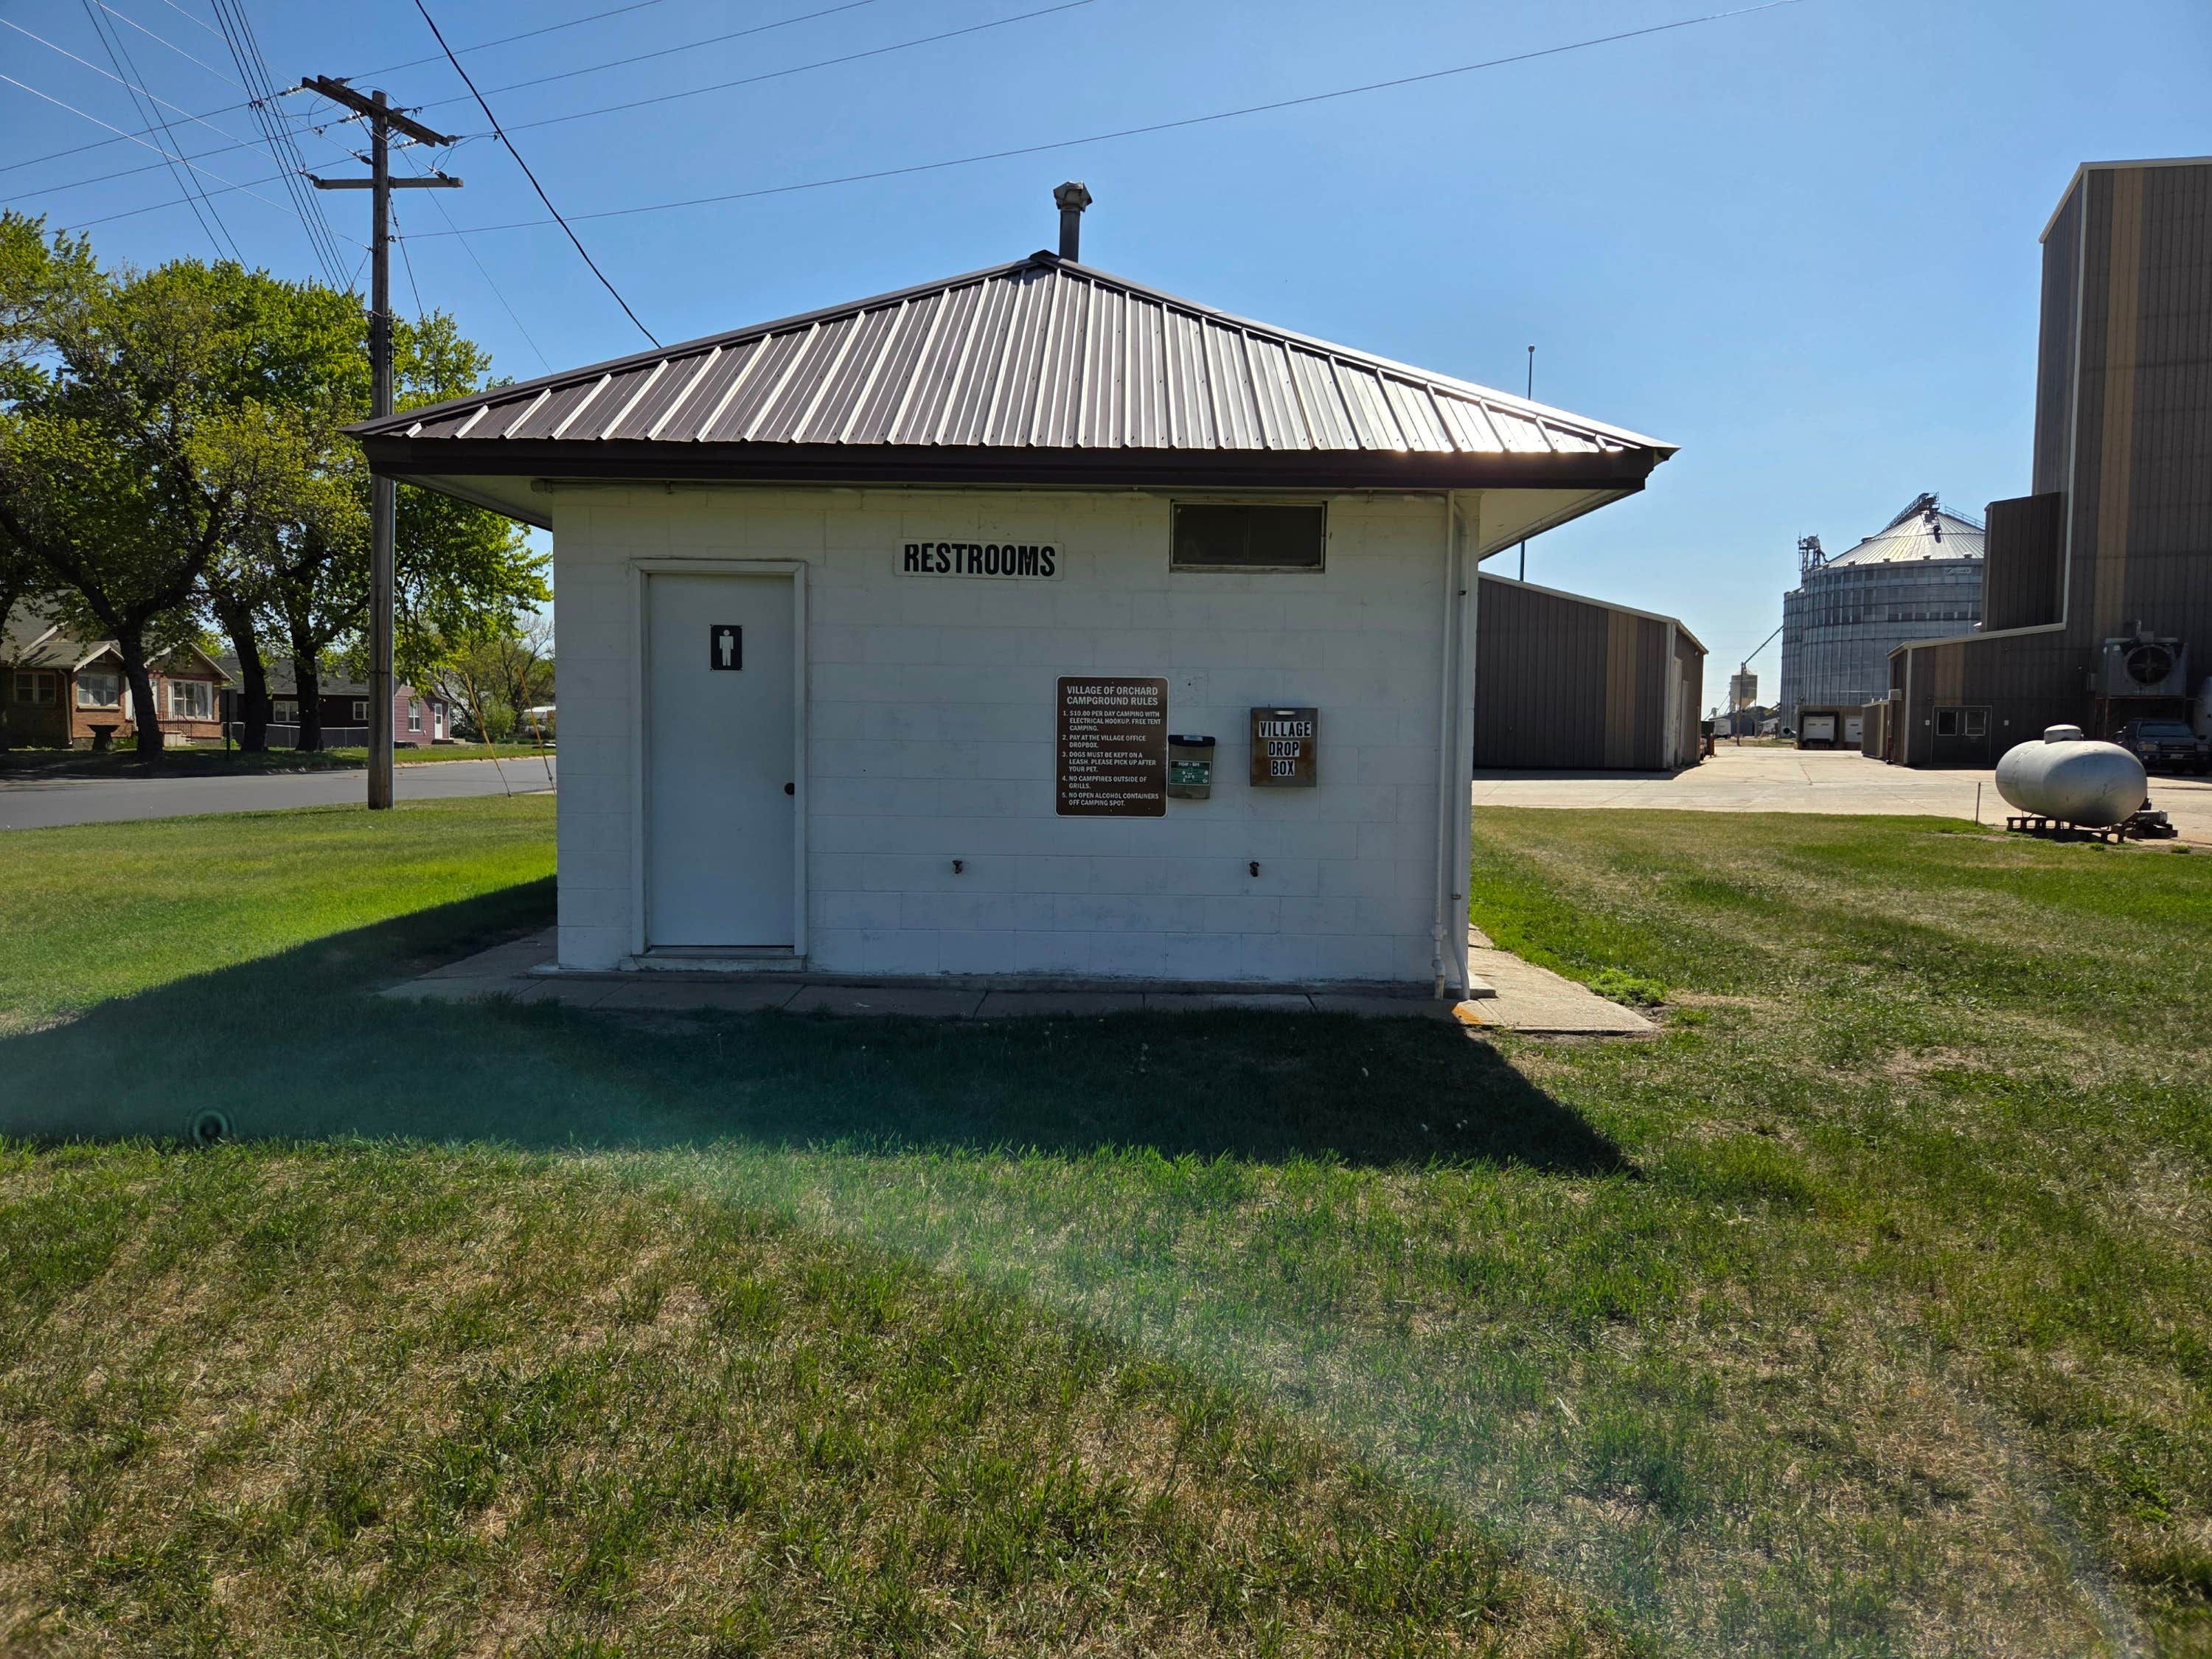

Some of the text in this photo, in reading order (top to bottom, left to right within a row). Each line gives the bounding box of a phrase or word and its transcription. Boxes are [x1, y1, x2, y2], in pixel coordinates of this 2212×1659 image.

[904, 542, 1055, 577] RESTROOMS
[1066, 686, 1158, 695] VILLAGE OF ORCHARD
[1066, 696, 1158, 706] CAMPGROUND RULES
[1260, 722, 1311, 737] VILLAGE
[1269, 741, 1299, 756] DROP
[1272, 760, 1294, 775] BOX
